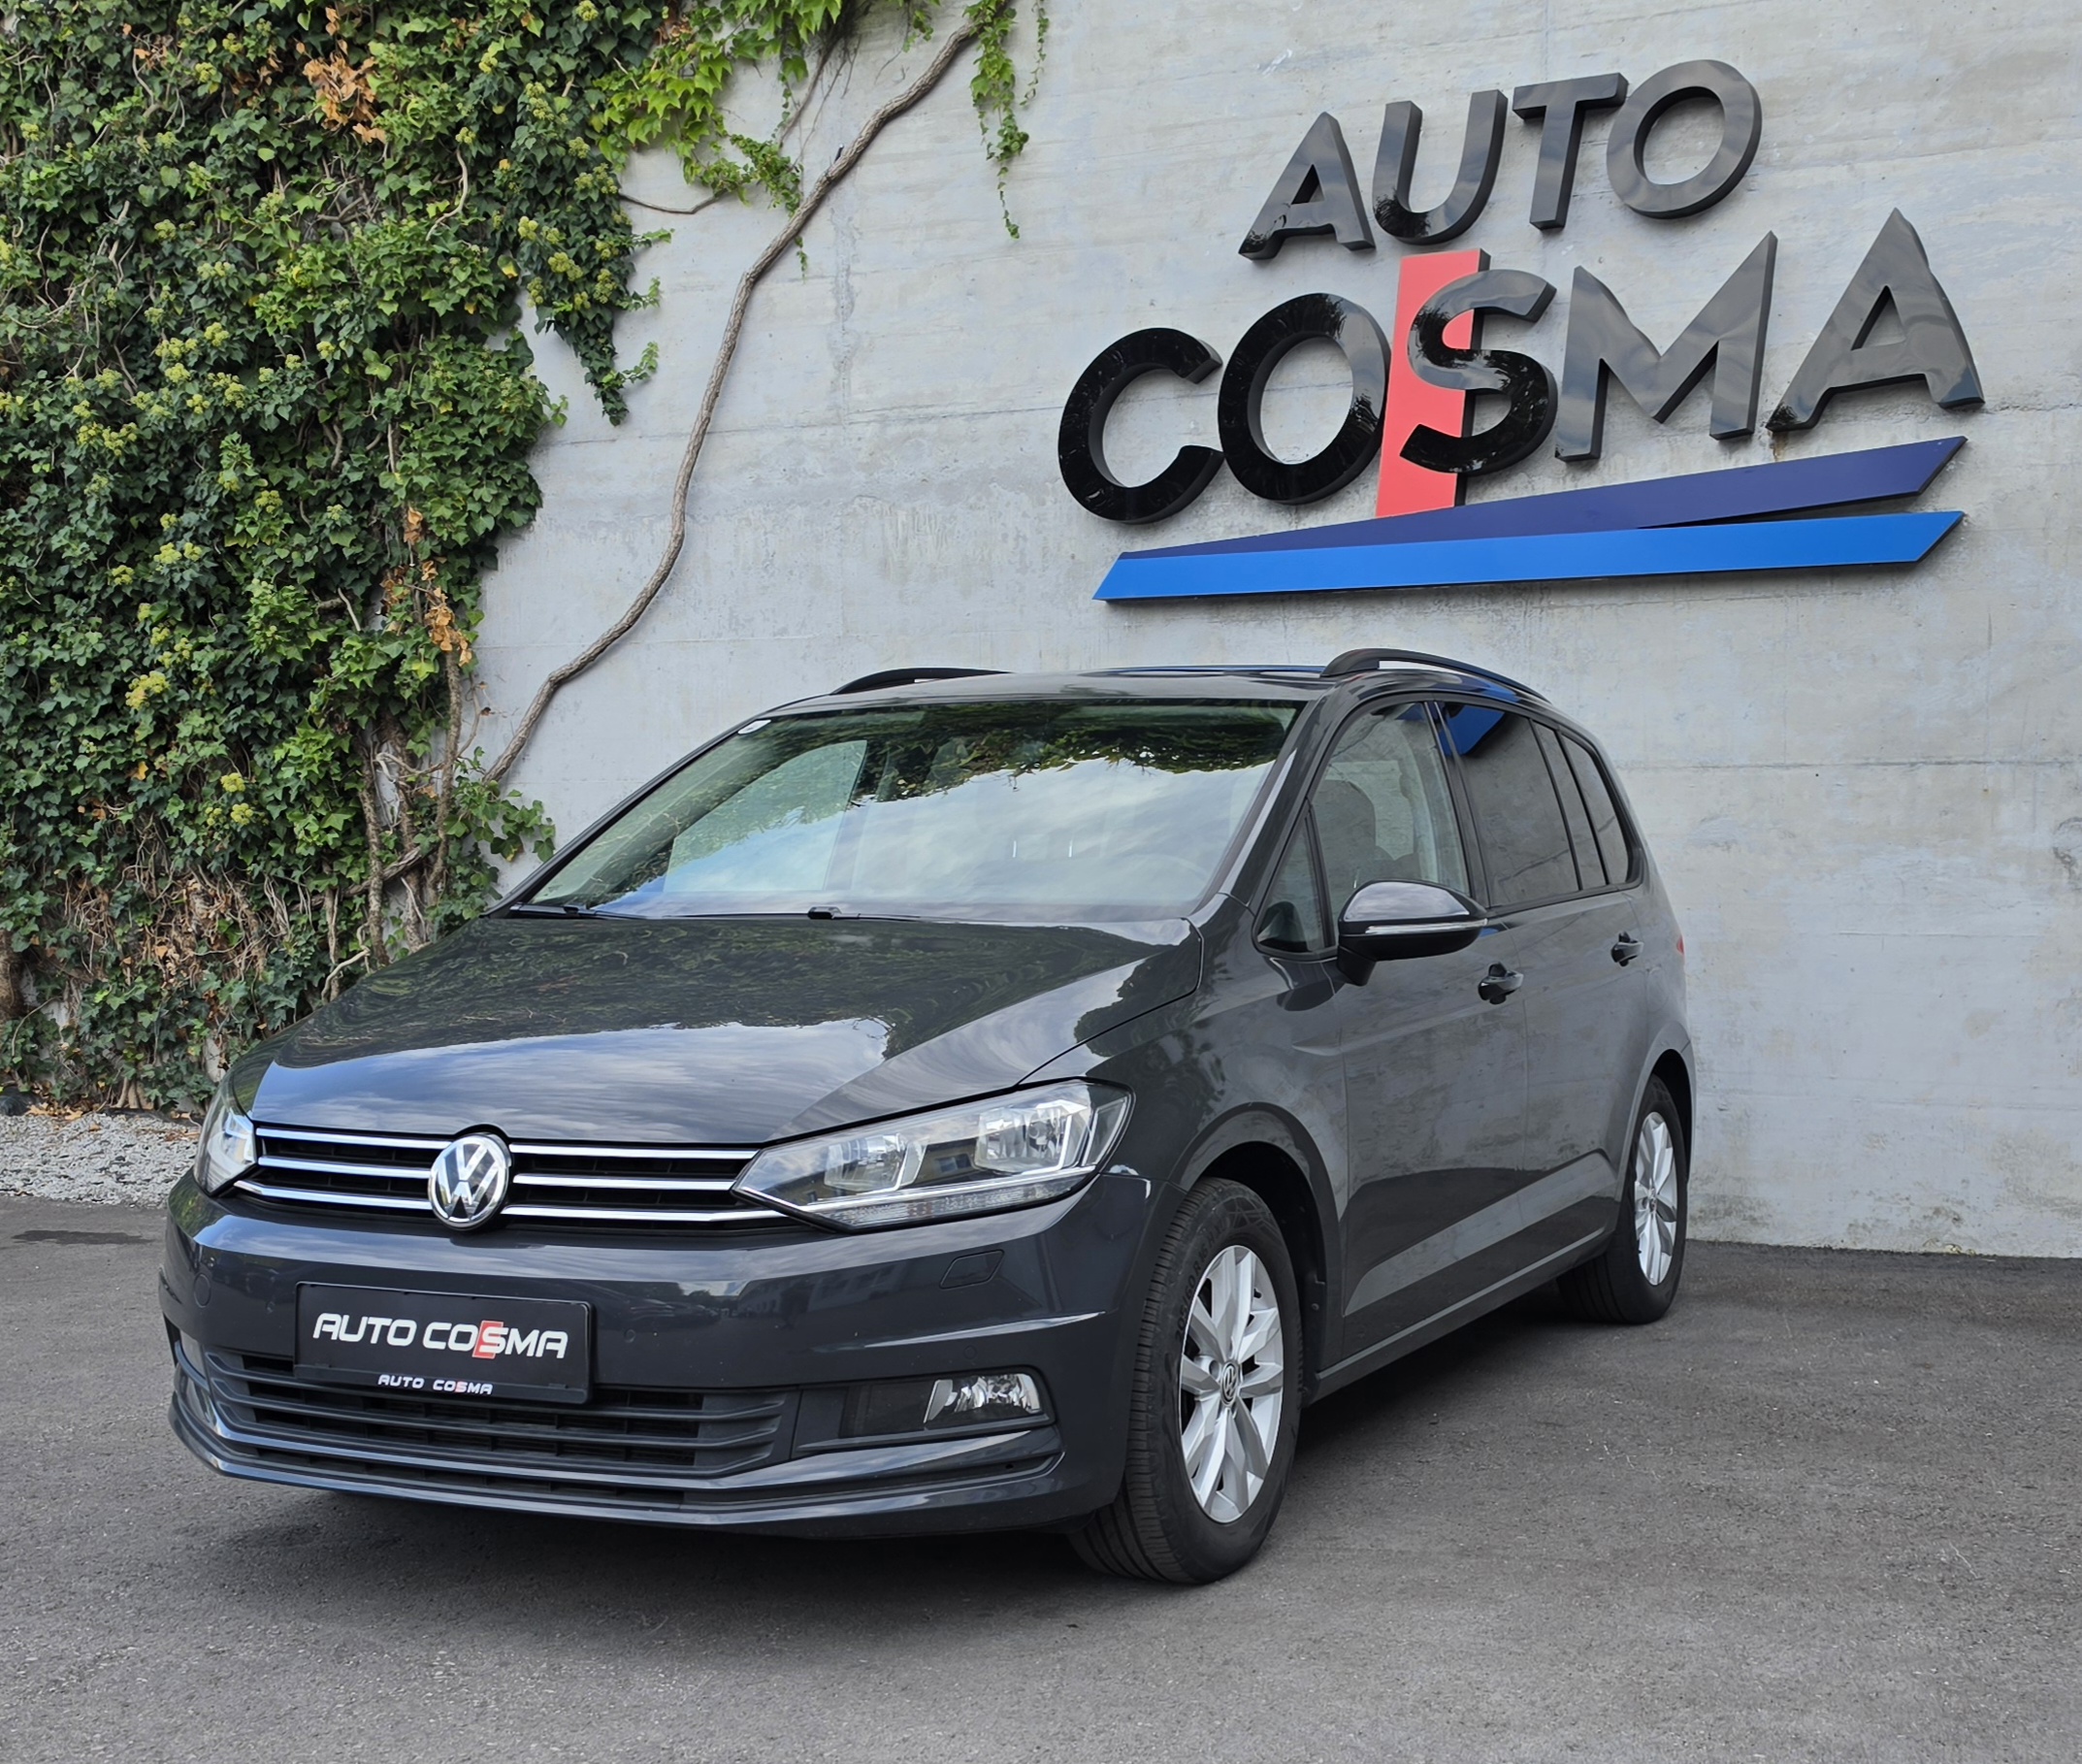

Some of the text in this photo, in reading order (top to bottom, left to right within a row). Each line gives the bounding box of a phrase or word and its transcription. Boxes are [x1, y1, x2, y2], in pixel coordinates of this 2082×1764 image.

[1238, 59, 1763, 260] AUTO
[1057, 207, 1986, 525] COSMA
[436, 1139, 504, 1222] VW
[313, 1313, 569, 1359] AUTO COSMA
[377, 1374, 494, 1395] AUTO COSMA
